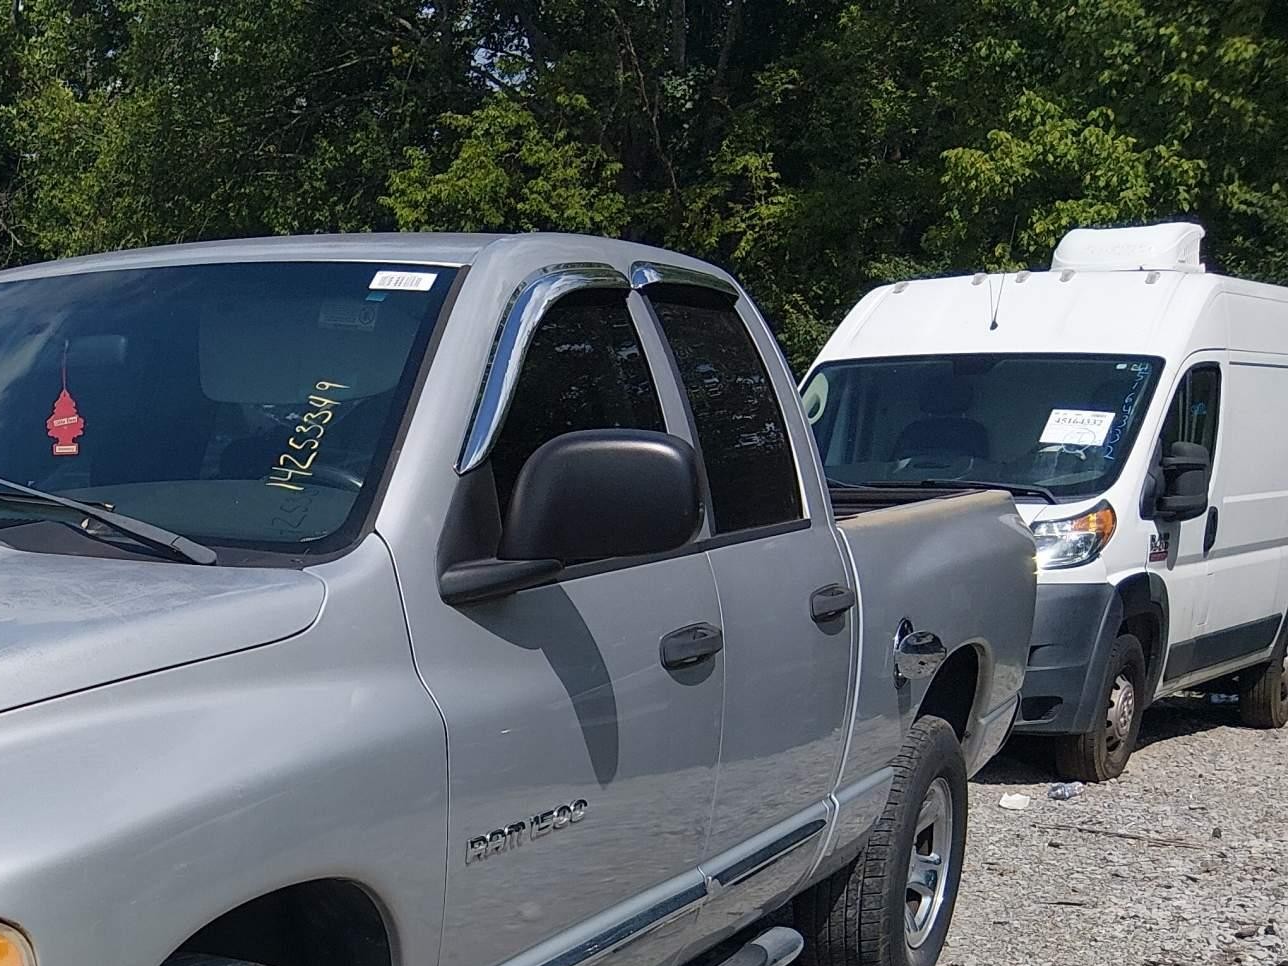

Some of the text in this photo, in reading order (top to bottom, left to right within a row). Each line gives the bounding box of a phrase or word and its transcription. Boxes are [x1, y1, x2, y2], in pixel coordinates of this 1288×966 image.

[265, 381, 352, 491] 14253349
[465, 799, 588, 865] RAM 1500
